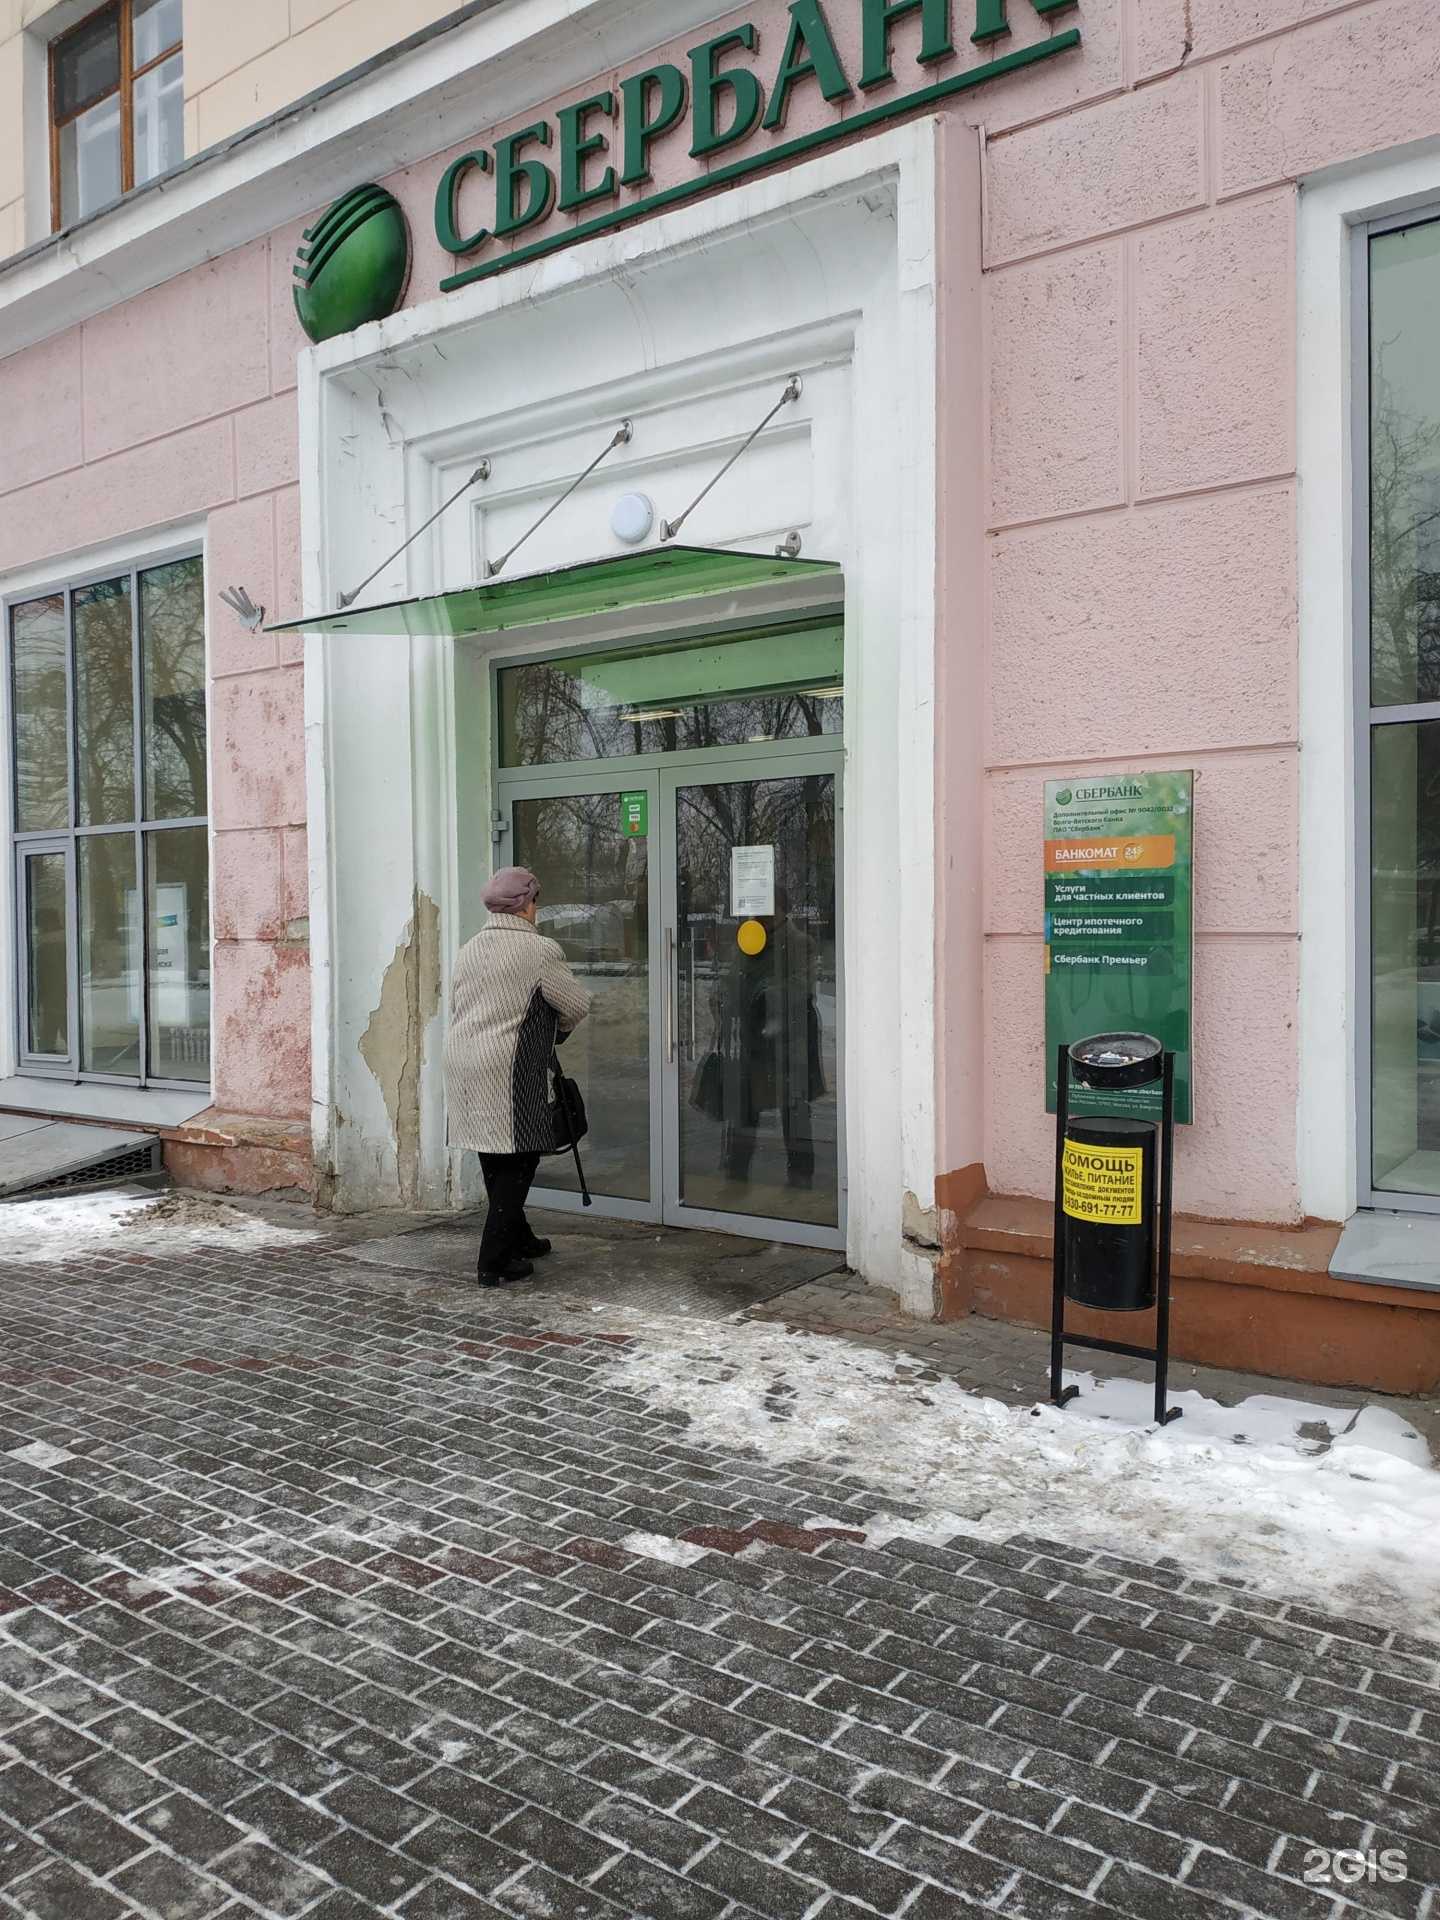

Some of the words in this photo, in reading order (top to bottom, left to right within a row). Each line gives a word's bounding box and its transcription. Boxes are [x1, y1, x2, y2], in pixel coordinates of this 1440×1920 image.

[435, 0, 1078, 256] СБЕРБАН
[1075, 785, 1143, 801] СБЕРБАНК
[1110, 807, 1127, 816] офис
[1055, 847, 1118, 860] БАНКОМАТ
[1054, 884, 1086, 895] Услуги
[1054, 893, 1072, 902] для
[1073, 891, 1114, 901] частных
[1115, 891, 1165, 900] клиентов
[1054, 917, 1083, 928] Центр
[1084, 917, 1143, 928] ипотечного
[1054, 926, 1122, 936] кредитования
[1054, 954, 1100, 965] Сбербанк
[1101, 955, 1148, 966] Премьер
[1088, 1173, 1135, 1185] ПИТАНИЕ
